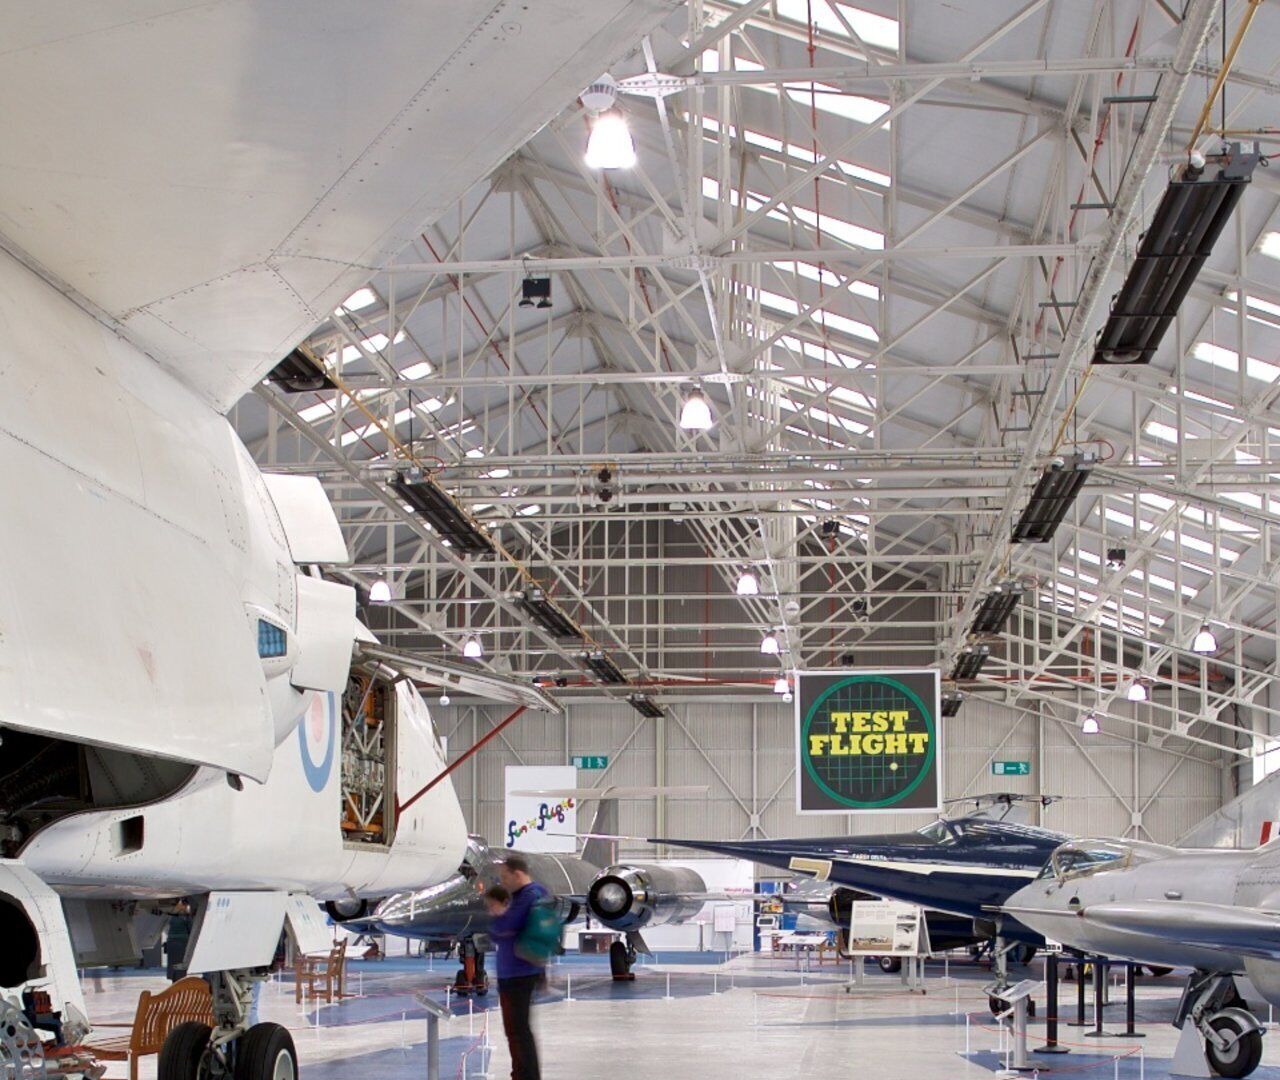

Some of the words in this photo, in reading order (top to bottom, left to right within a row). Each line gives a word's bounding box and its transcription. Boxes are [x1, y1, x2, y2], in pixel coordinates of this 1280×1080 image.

[831, 711, 909, 733] TEST
[809, 733, 929, 756] FLIGHT
[506, 820, 528, 848] fun
